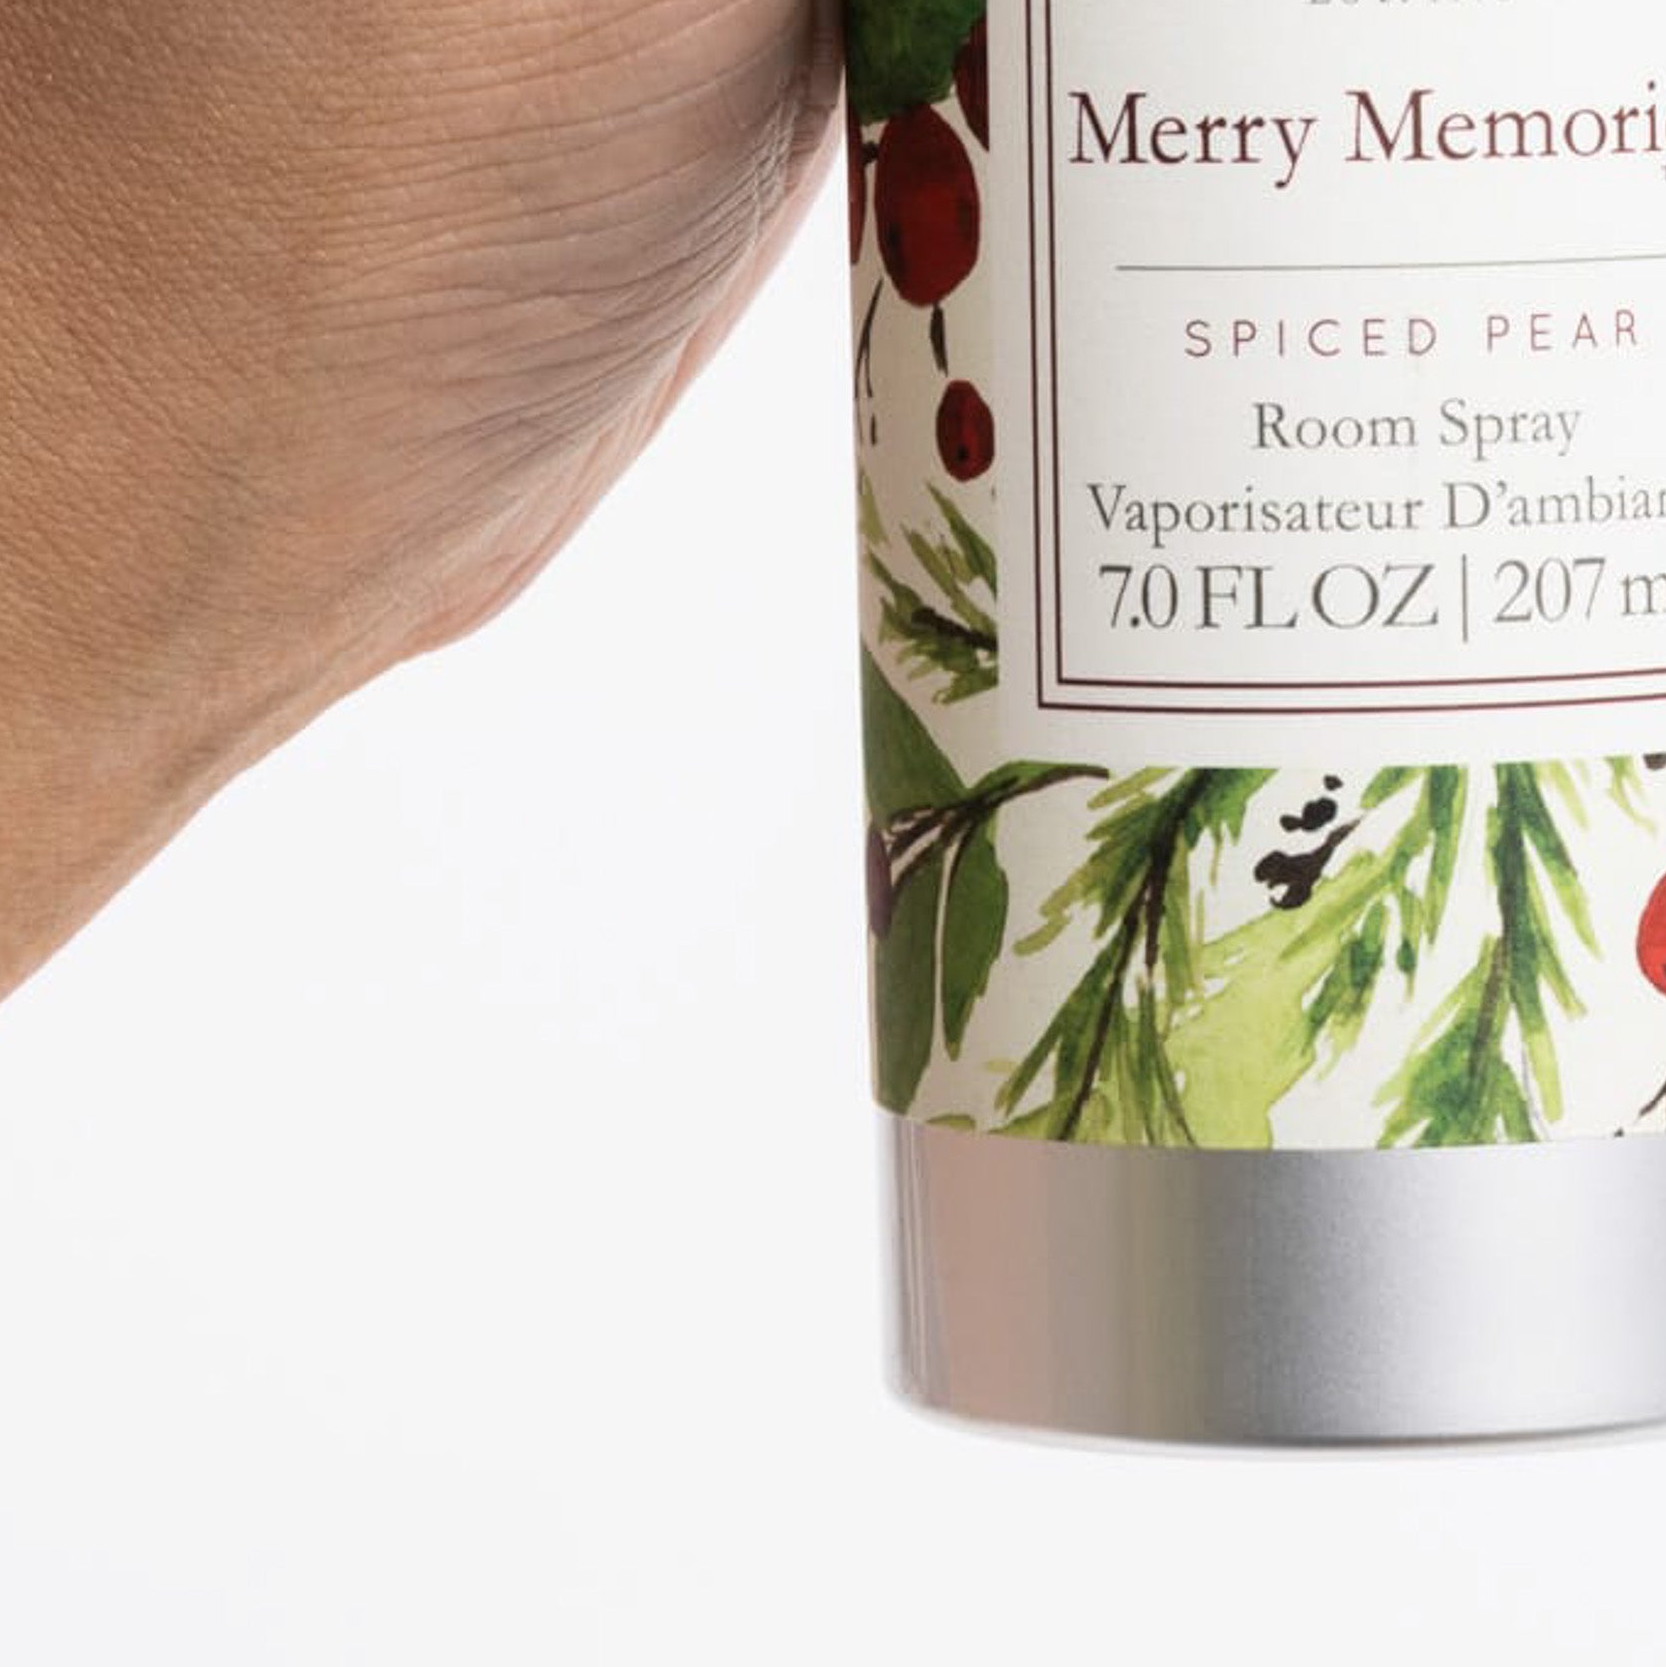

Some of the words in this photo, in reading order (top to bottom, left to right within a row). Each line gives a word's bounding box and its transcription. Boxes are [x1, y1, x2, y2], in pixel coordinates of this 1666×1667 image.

[1068, 91, 1318, 190] Merry
[1184, 317, 1437, 359] SPICED
[1486, 308, 1638, 353] PEAR
[1253, 402, 1416, 449] Room
[1439, 397, 1581, 463] Spray
[1086, 482, 1424, 550] Vaporisateur
[1098, 564, 1179, 629] 7.0
[1196, 564, 1298, 630] FL
[1311, 563, 1439, 629] OZ
[1493, 556, 1607, 624] 207
